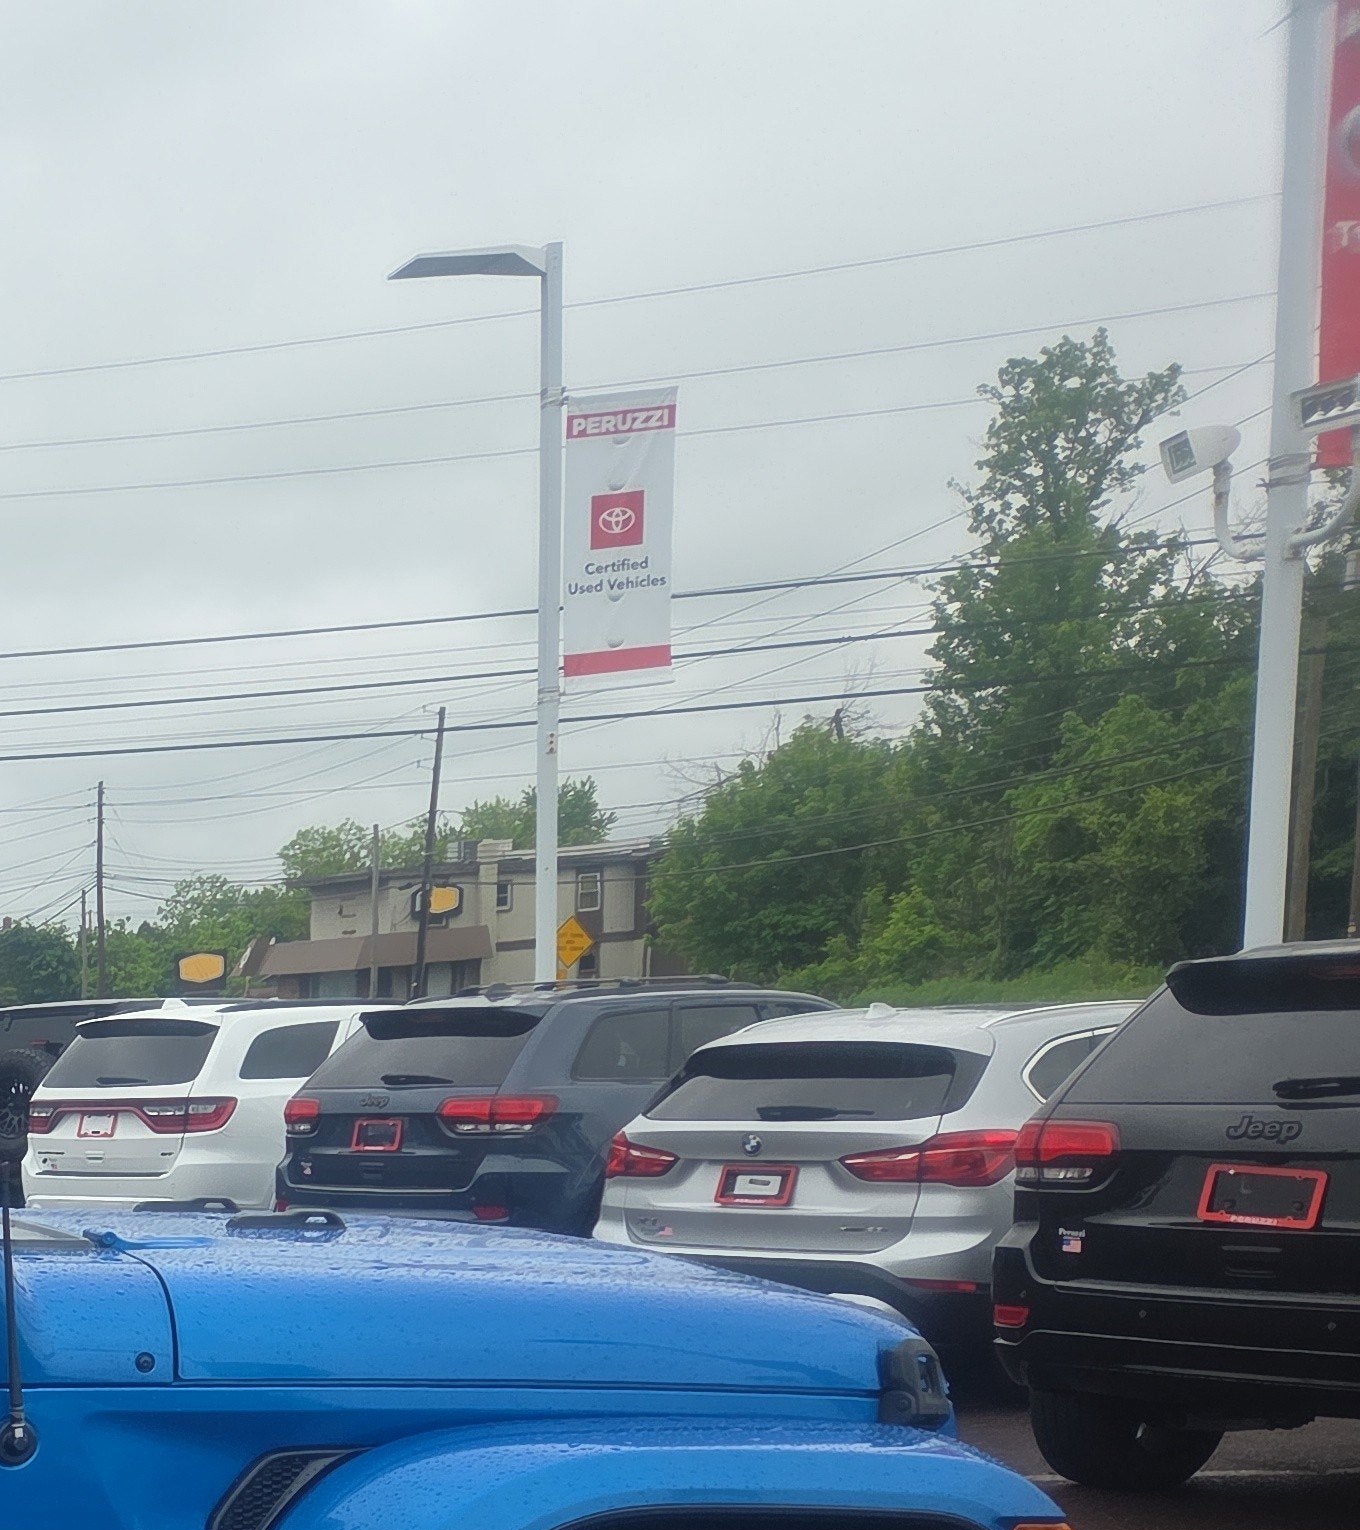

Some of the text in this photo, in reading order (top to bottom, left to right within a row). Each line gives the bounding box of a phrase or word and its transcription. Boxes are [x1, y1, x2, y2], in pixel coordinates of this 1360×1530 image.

[572, 408, 669, 436] PERUZZI
[584, 556, 649, 575] Certified
[568, 574, 667, 595] Used Vehicles
[1226, 1115, 1303, 1145] Jeep
